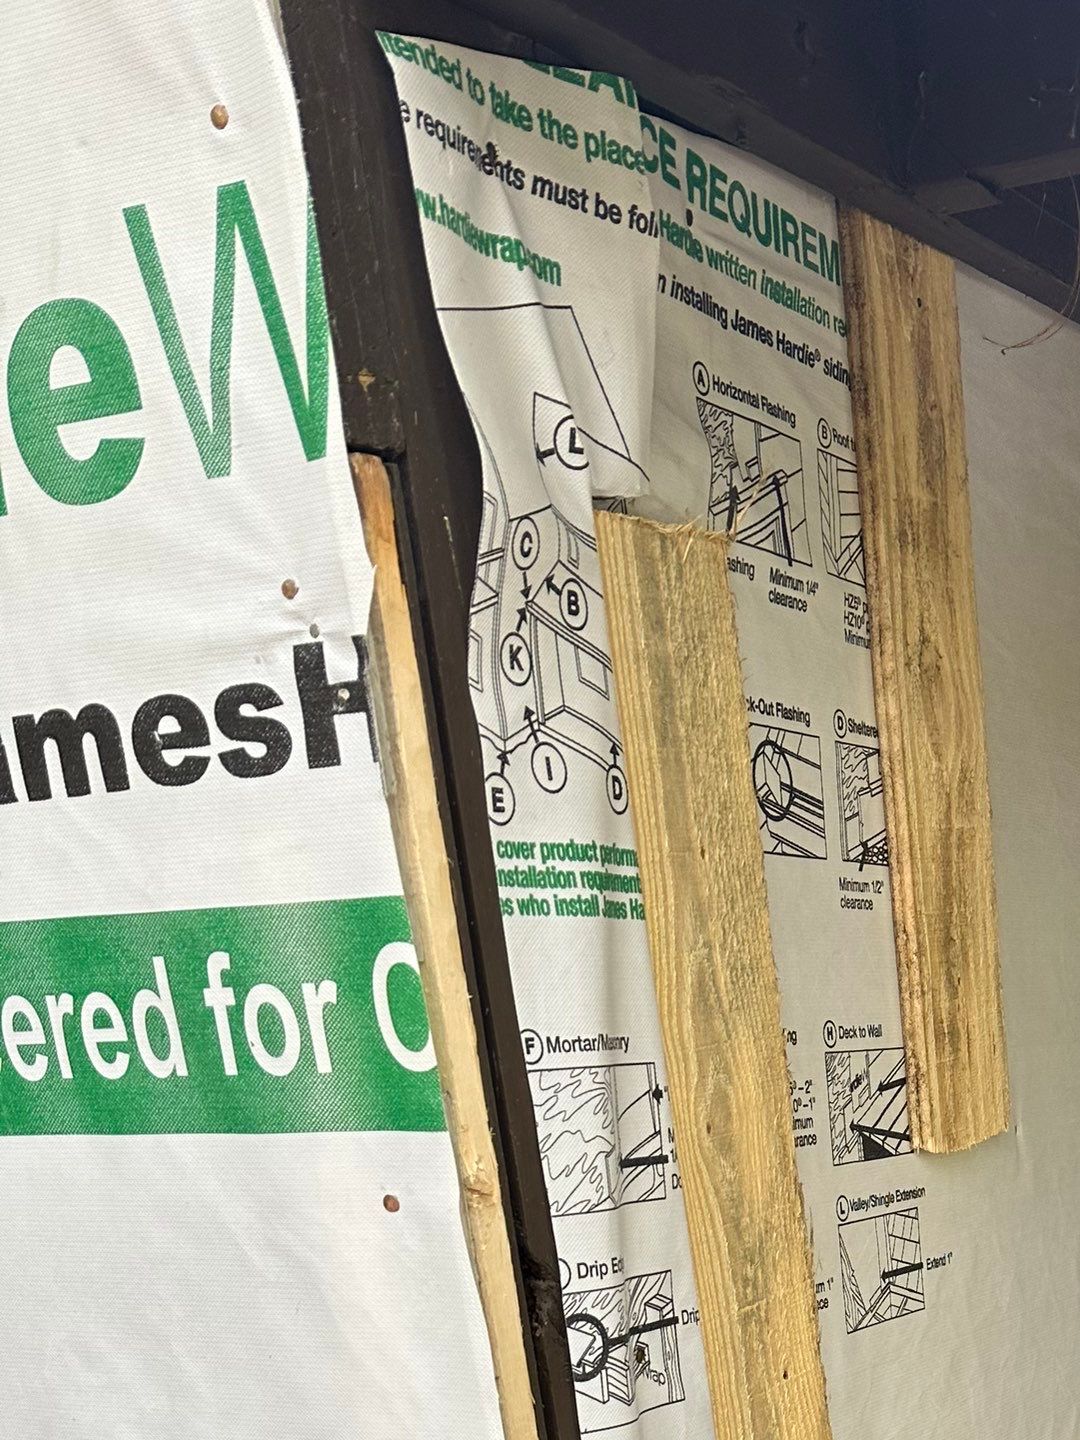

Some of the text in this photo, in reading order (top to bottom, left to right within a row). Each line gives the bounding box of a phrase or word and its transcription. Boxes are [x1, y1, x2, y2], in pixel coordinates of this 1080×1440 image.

[466, 67, 485, 106] to
[489, 81, 533, 132] take
[537, 107, 579, 150] the
[531, 175, 589, 214] must
[594, 192, 622, 225] be
[705, 245, 758, 291] written
[761, 269, 831, 330] installation
[670, 274, 728, 331] installing
[731, 309, 774, 348] James
[712, 374, 760, 409] Horizontal
[761, 395, 797, 429] Flashing
[769, 567, 804, 593] Minimum
[768, 587, 808, 612] clearance
[0, 634, 380, 804] mesH
[776, 702, 811, 728] Flashing
[496, 839, 536, 860] cover
[540, 838, 599, 865] product
[839, 877, 871, 895] Minimum
[517, 893, 550, 917] who
[554, 893, 600, 918] install
[840, 895, 874, 911] clearance
[204, 951, 338, 1077] for
[839, 1025, 858, 1040] Deck
[859, 1026, 866, 1039] to
[867, 1024, 883, 1038] Wall
[895, 1186, 926, 1202] Extension
[577, 1260, 608, 1280] Drip
[926, 1253, 947, 1271] Extend
